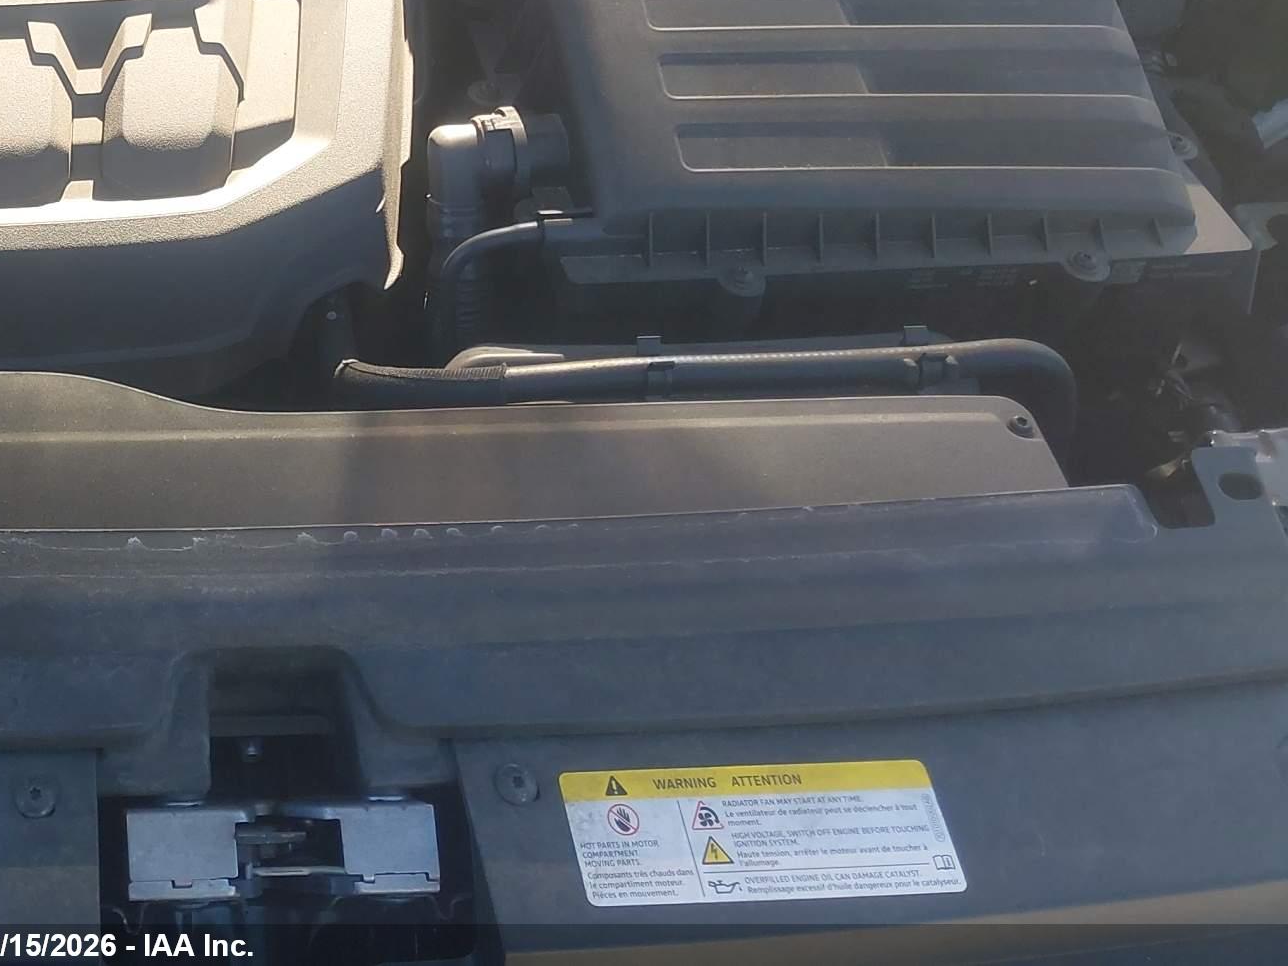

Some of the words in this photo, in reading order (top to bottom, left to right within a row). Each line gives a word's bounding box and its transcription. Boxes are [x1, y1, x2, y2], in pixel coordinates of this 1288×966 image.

[653, 776, 717, 790] WARNING
[731, 773, 802, 787] ATTENTION
[722, 799, 759, 807] RADIATOR
[760, 798, 774, 806] FAN
[793, 797, 815, 805] START
[817, 796, 826, 804] AT
[725, 810, 734, 818] Le
[735, 809, 775, 817] ventilateur
[777, 808, 787, 816] de
[788, 807, 822, 815] radiateur
[825, 807, 842, 815] peut
[728, 819, 762, 827] moment.
[731, 831, 753, 839] HIGH
[786, 829, 815, 838] SWITCH
[816, 828, 831, 836] OFF
[832, 827, 860, 836] ENGINE
[862, 826, 890, 835] BEFORE
[892, 824, 930, 834] TOUCHING
[580, 842, 596, 850] HOT
[598, 841, 620, 849] PARTS
[734, 839, 767, 848] IGNITION
[737, 851, 760, 859] Haute
[830, 847, 857, 855] moteur
[859, 846, 880, 854] avant
[881, 845, 891, 853] de
[892, 843, 921, 852] toucher
[585, 859, 615, 868] MOVING
[588, 871, 632, 880] Composants
[649, 869, 676, 877] chauds
[676, 868, 694, 876] dans
[744, 875, 790, 885] OVERFILLED
[791, 874, 820, 883] ENGINE
[821, 873, 833, 882] OIL
[833, 872, 851, 881] CAN
[852, 871, 884, 880] DAMAGE
[598, 880, 653, 890] compartiment
[747, 885, 794, 895] Remplissage
[796, 883, 825, 892] excessif
[854, 881, 892, 891] dangereux
[894, 881, 912, 889] pour
[629, 890, 679, 898] mouvement.
